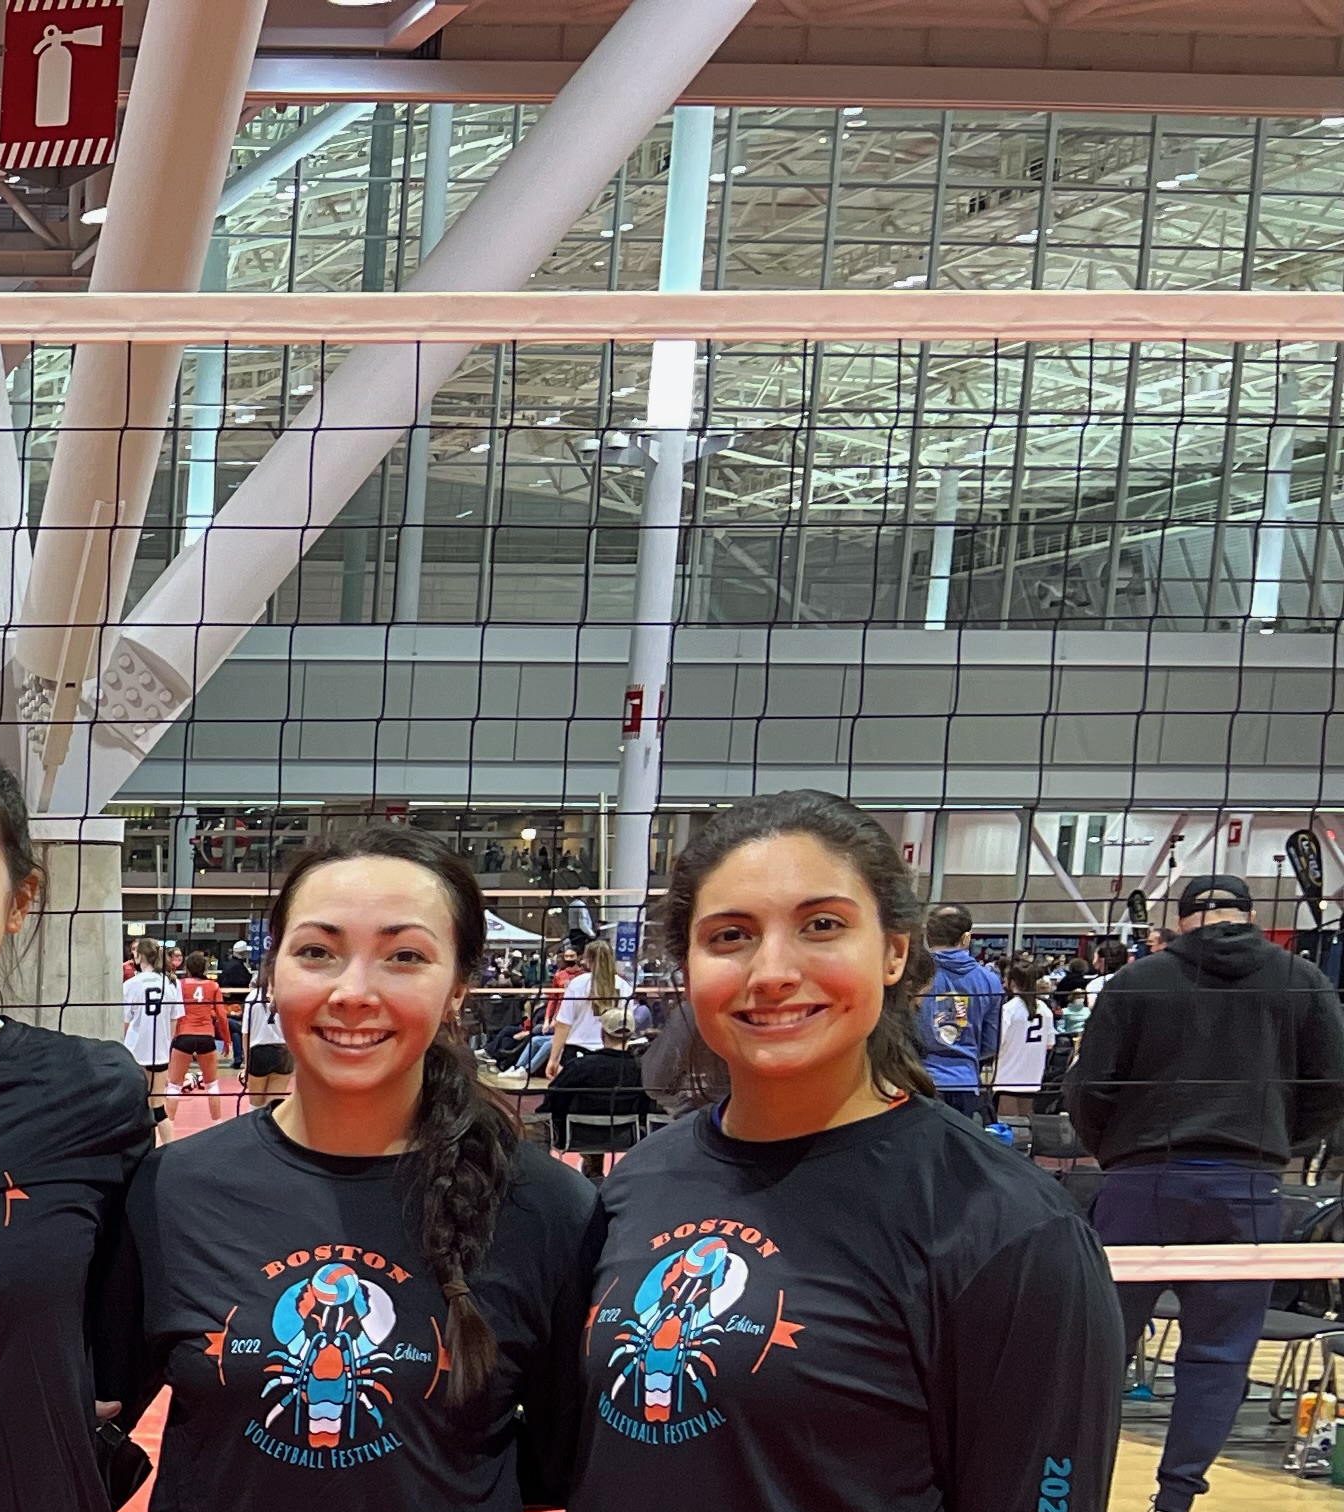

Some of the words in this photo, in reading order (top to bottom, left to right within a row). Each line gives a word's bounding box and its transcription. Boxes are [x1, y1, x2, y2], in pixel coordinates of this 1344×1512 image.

[618, 937, 637, 953] 35
[145, 987, 162, 1016] 6
[192, 986, 204, 1002] 4
[1026, 1013, 1044, 1043] 2
[649, 1218, 781, 1259] BOSTON
[260, 1244, 413, 1285] BOSTON
[230, 1338, 261, 1355] 2022
[597, 1391, 659, 1446] VOLLEYBALL
[663, 1407, 727, 1445] FESTIVAL
[243, 1419, 325, 1470] VOLLEYBALL
[330, 1432, 403, 1469] FESTIVAL
